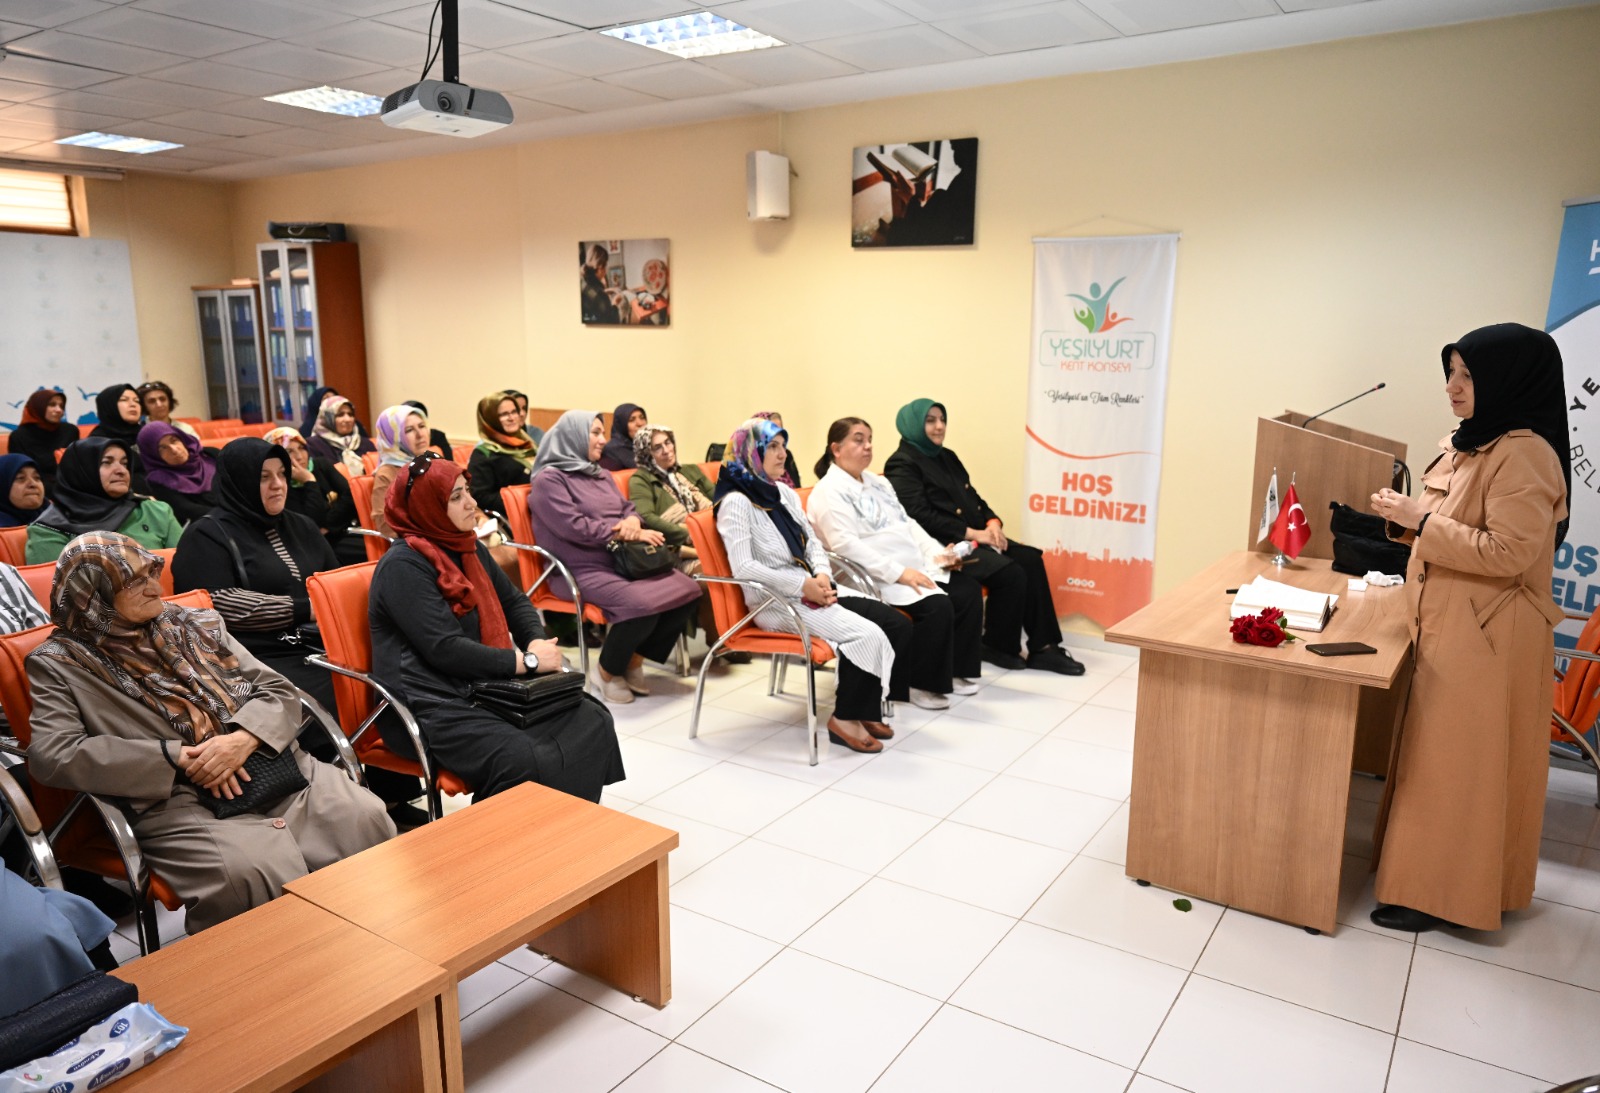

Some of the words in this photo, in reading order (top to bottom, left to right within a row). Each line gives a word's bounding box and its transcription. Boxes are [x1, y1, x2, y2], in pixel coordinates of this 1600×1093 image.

[1060, 360, 1085, 371] KENT
[1061, 471, 1113, 496] HOŞ
[1570, 444, 1600, 494] BEL
[1554, 541, 1599, 577] OŞ
[1552, 577, 1600, 613] ELD
